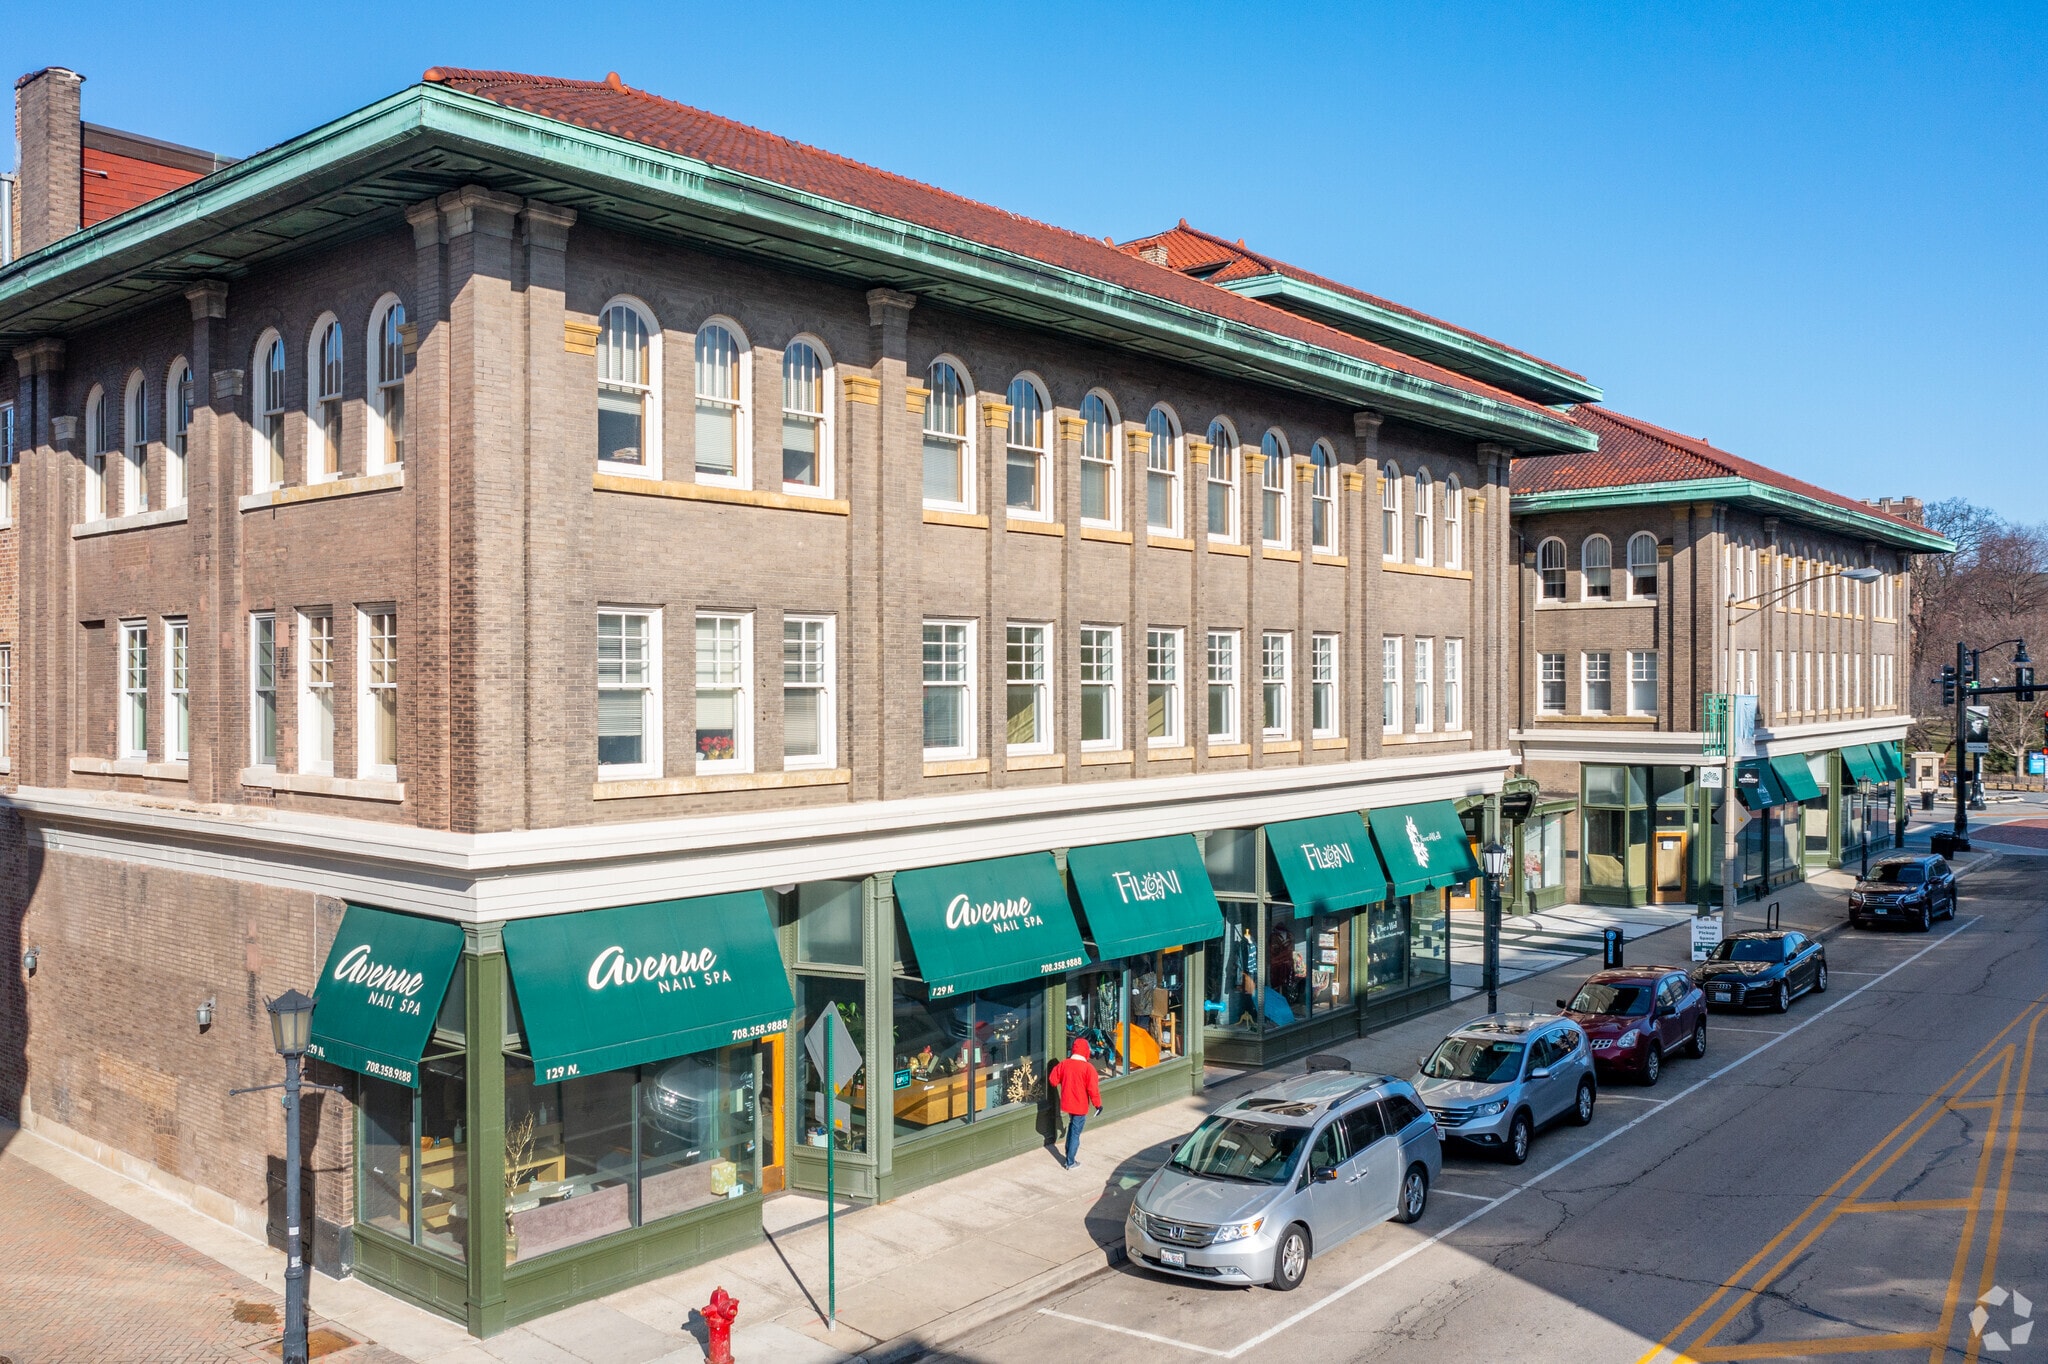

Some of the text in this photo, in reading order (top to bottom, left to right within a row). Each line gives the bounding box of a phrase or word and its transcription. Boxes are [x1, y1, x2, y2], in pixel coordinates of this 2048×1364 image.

[1300, 842, 1354, 871] FILONI
[1111, 869, 1182, 904] FILONI
[945, 894, 1031, 929] Avenue
[993, 915, 1043, 934] NAIL SPA
[334, 944, 424, 997] Avenue
[587, 946, 717, 991] Avenue
[1040, 956, 1083, 974] 708.358.9888
[658, 969, 732, 994] NAIL SPA
[932, 986, 947, 996] 129
[367, 991, 421, 1016] NAIL SPA
[732, 1018, 788, 1041] 708.358.9888
[545, 1063, 580, 1081] 129 N.
